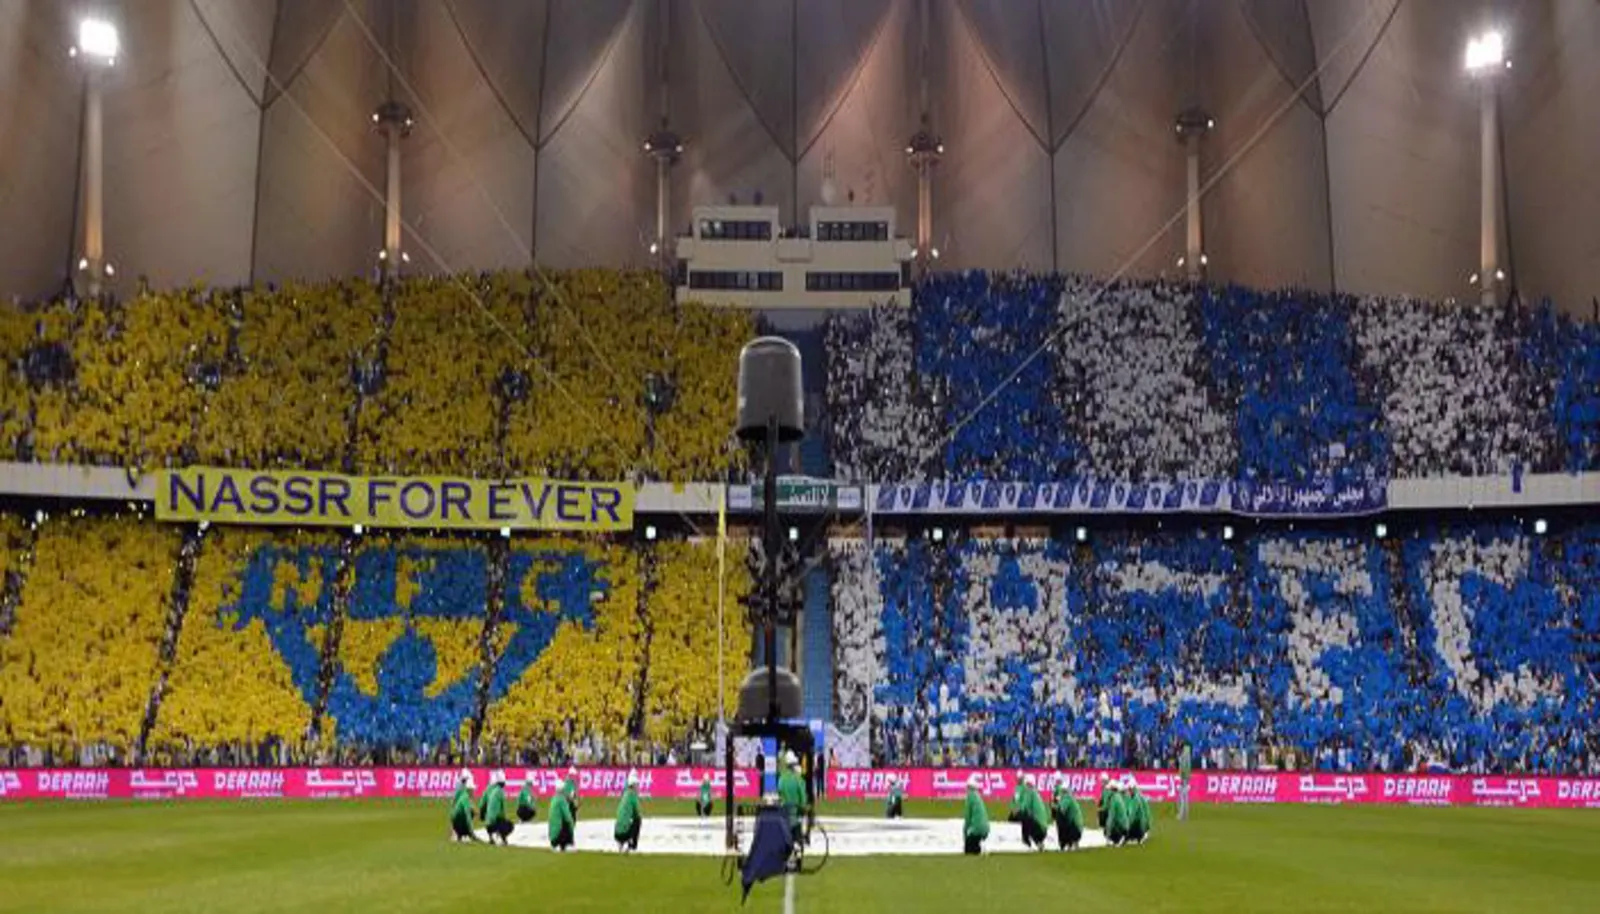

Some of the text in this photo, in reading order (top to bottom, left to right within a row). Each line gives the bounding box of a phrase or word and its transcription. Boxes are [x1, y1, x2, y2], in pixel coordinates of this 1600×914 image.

[169, 473, 623, 524] NASSR FOR EVER
[268, 555, 563, 615] NFC
[38, 771, 109, 791] DERAAH
[214, 771, 285, 791] DERAAH
[579, 769, 652, 790] DERAH
[1207, 774, 1277, 794] DERAAH
[1383, 777, 1451, 798] DERAAH
